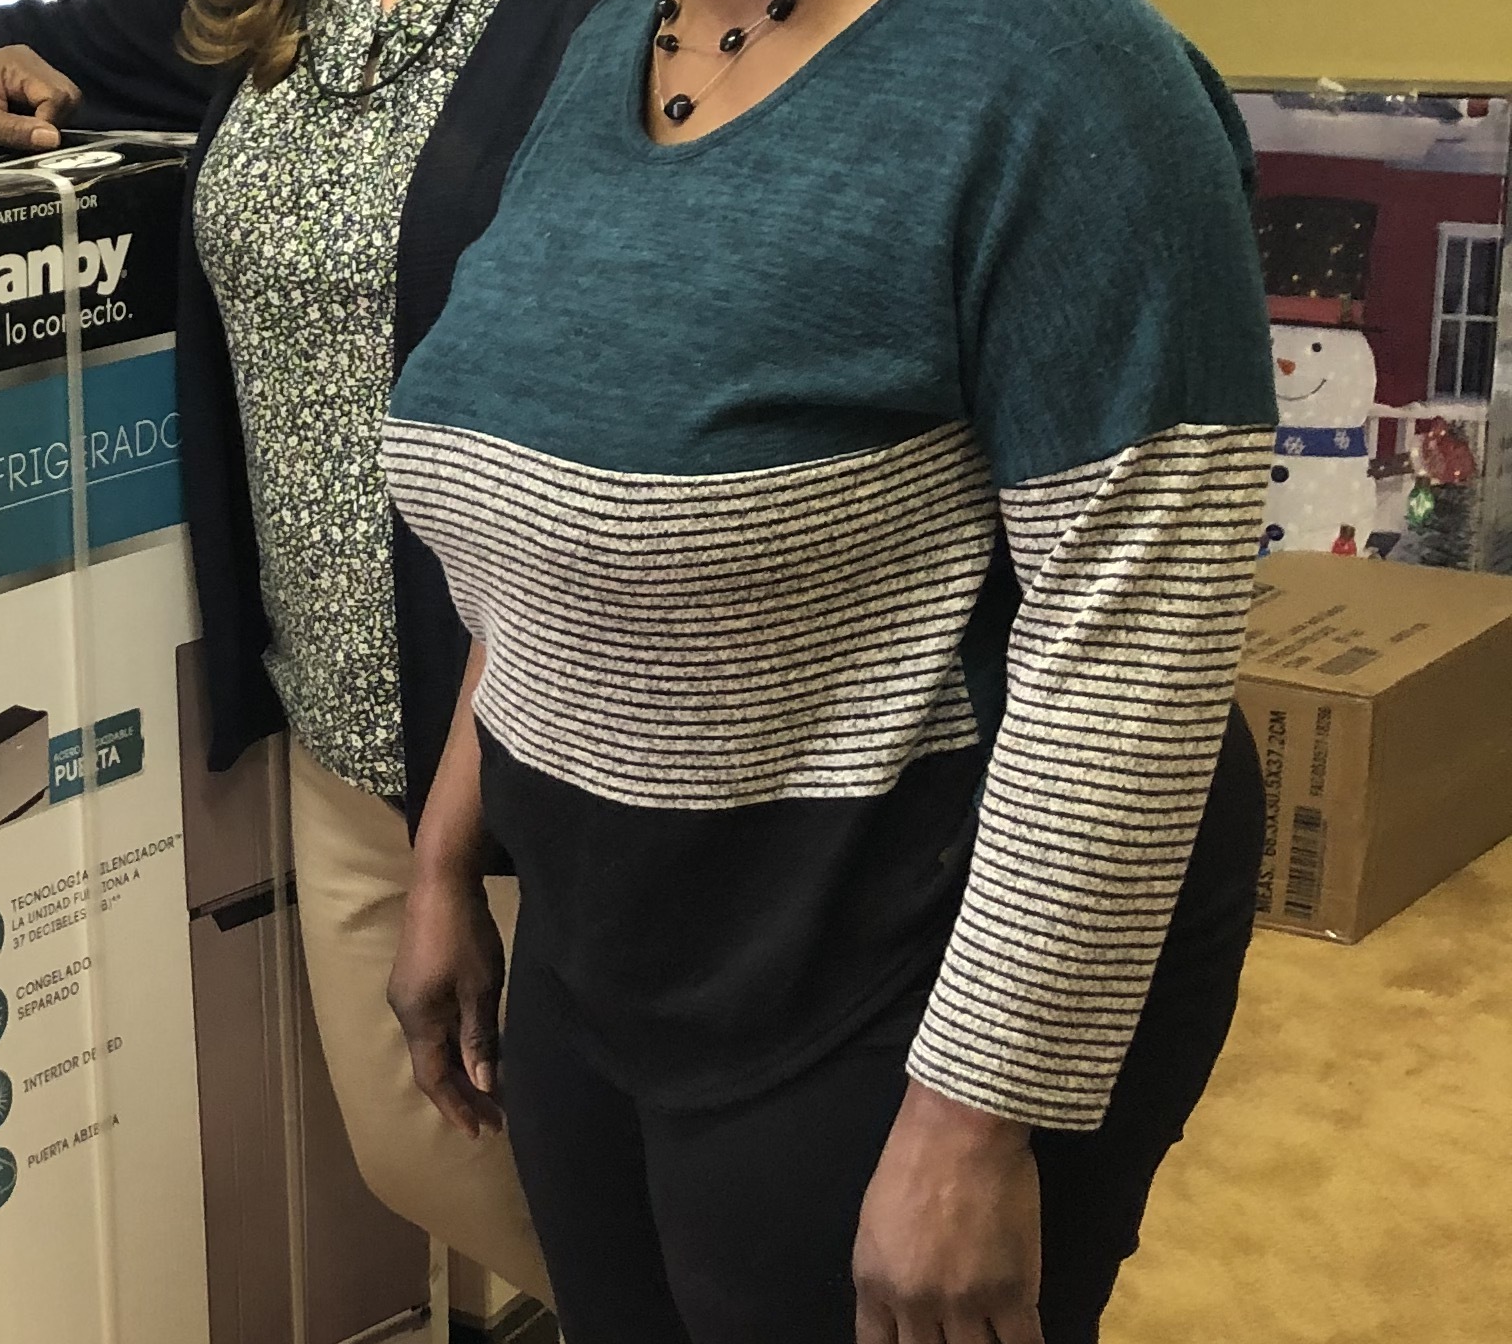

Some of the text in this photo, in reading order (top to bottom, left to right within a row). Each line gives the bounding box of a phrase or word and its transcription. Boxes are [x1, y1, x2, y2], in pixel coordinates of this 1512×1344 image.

[30, 194, 98, 219] POSTIOR
[5, 312, 27, 346] lo
[32, 298, 134, 339] corecto.
[54, 745, 121, 787] PUETA
[10, 869, 89, 913] TECNOLOGÍA
[11, 915, 25, 932] LA
[28, 896, 71, 925] UNIDAD
[133, 868, 141, 879] A
[12, 934, 25, 950] 37
[28, 908, 88, 943] DECIBELES
[15, 956, 92, 1000] CONGELADO
[17, 981, 80, 1020] SEPARADO
[23, 1055, 80, 1093] INTERIOR
[106, 1036, 124, 1055] ED
[27, 1137, 70, 1169] PUERTA
